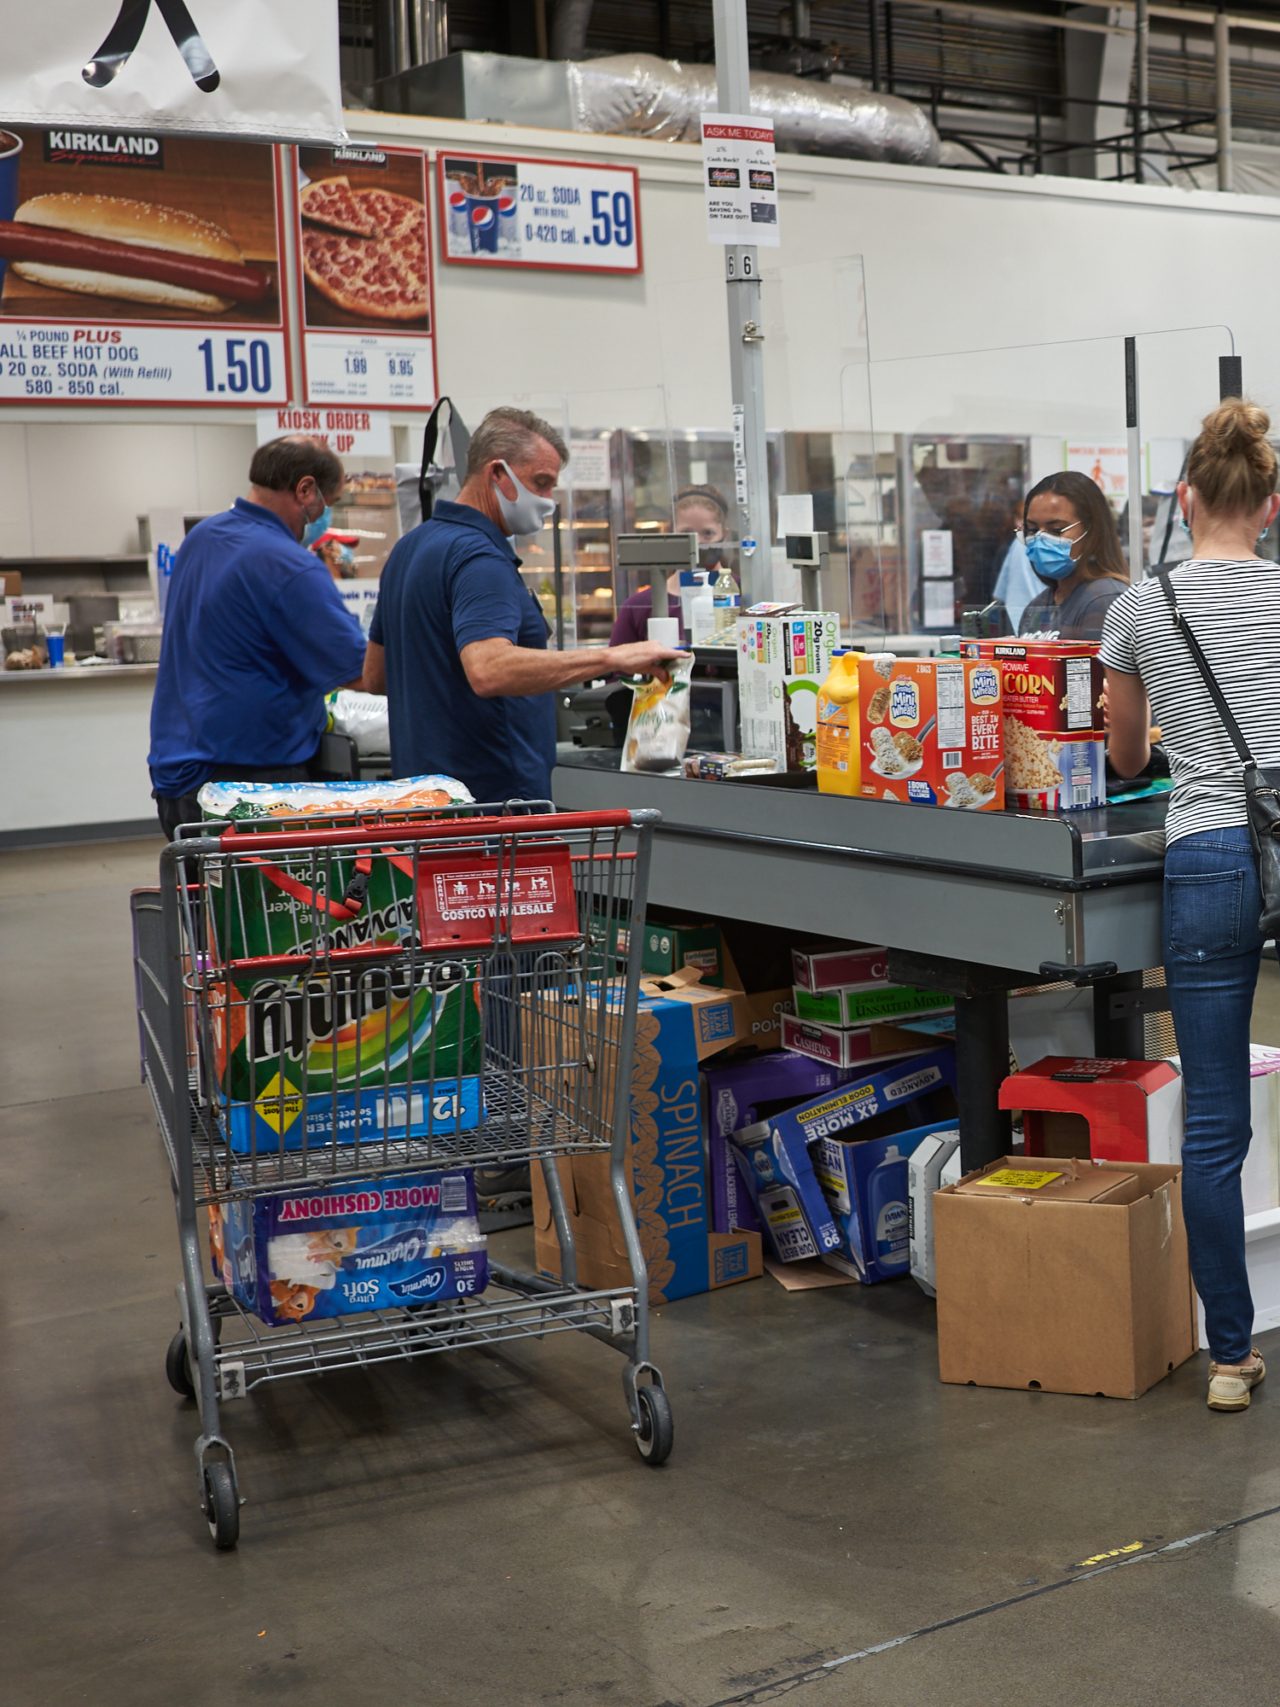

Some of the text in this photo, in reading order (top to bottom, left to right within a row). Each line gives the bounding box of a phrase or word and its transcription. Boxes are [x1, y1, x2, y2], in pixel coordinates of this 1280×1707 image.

[706, 127, 726, 137] ASK
[728, 128, 741, 138] ME
[50, 131, 159, 155] KIRKLAND
[51, 149, 160, 167] Signature
[334, 148, 386, 163] KIRKLAND
[520, 184, 534, 203] 20
[553, 186, 580, 205] SODA
[583, 190, 633, 247] .59
[526, 224, 578, 244] 0-420 cal.
[743, 255, 751, 276] 6
[30, 331, 69, 342] POUND
[73, 330, 122, 343] PLUS
[0, 344, 139, 361] ALL BEEF HOT DOG
[8, 362, 173, 382] 20 oz. SODA (With Refill)
[198, 338, 272, 394] 1.50
[25, 379, 53, 394] 580
[68, 380, 94, 394] 850
[99, 380, 125, 396] cal.
[277, 410, 370, 431] KIOSK ORDER
[813, 620, 823, 674] 20g Protein
[966, 646, 978, 657] 44
[995, 646, 1026, 656] KIRKLAND
[916, 665, 932, 674] 2 BAGS
[974, 675, 996, 688] Mini
[1003, 673, 1056, 697] CORN
[893, 692, 915, 705] Mini
[972, 684, 997, 700] Wheats
[1020, 696, 1038, 705] BUTTER
[891, 703, 917, 719] Wheats
[971, 715, 999, 724] BEST IN
[972, 723, 997, 735] EVERY
[972, 734, 999, 751] BITE
[441, 909, 485, 921] COSTCO
[856, 993, 951, 1018] UNSALTED MIXED
[793, 1033, 832, 1058] CASHEWS
[889, 1069, 937, 1098] ADVANCED
[432, 1095, 466, 1122] 12
[799, 1086, 872, 1123] ODOR ELIMINATION
[806, 1102, 879, 1143] 4X MORE
[660, 1079, 704, 1231] SPINACH
[820, 1151, 842, 1173] LEAN
[279, 1185, 441, 1222] MORE CUSHIONY
[777, 1228, 809, 1248] CLEAN
[824, 1233, 840, 1248] 90
[355, 1236, 422, 1270] Charmin
[342, 1279, 380, 1299] Soft
[401, 1271, 442, 1297] Charmin
[456, 1279, 476, 1293] 30
[349, 1293, 376, 1304] Ultra
